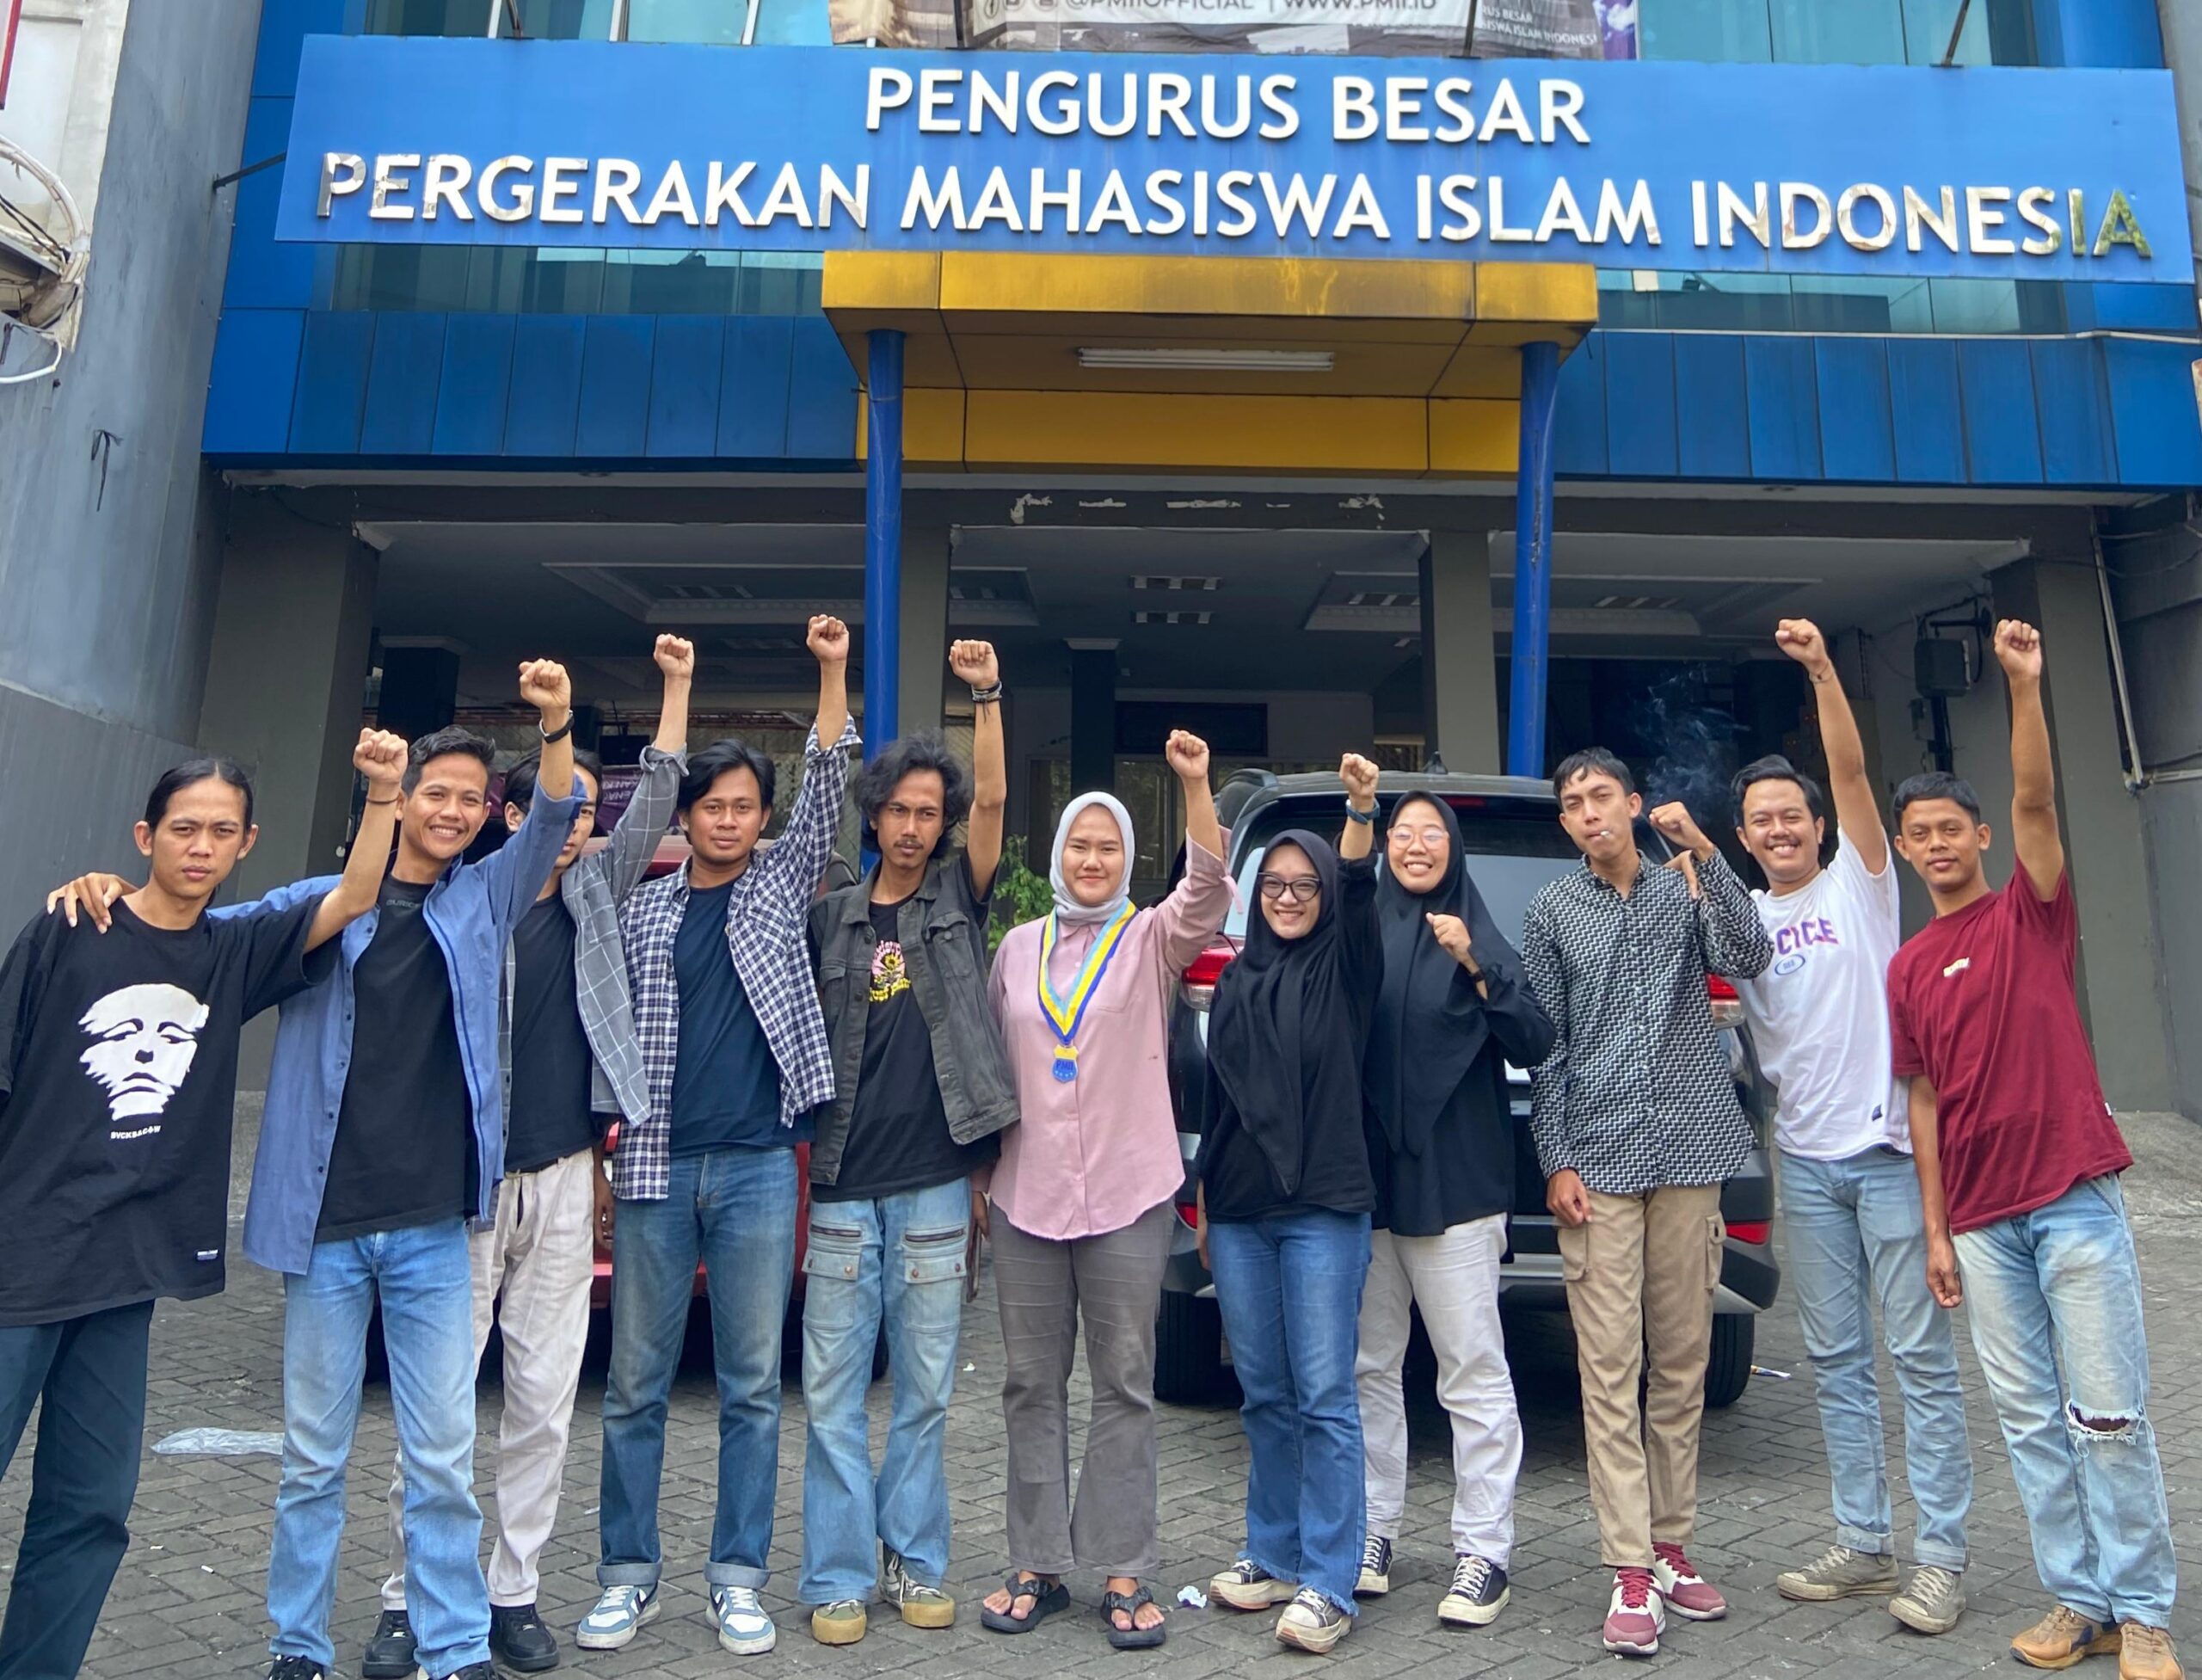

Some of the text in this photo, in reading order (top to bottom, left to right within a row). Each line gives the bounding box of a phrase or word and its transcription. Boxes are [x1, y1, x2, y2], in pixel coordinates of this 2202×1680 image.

[866, 67, 1591, 145] PENGURUS BESAR
[316, 151, 2153, 258] PERGERAKAN MAHASISWA ISLAM INDONESIA
